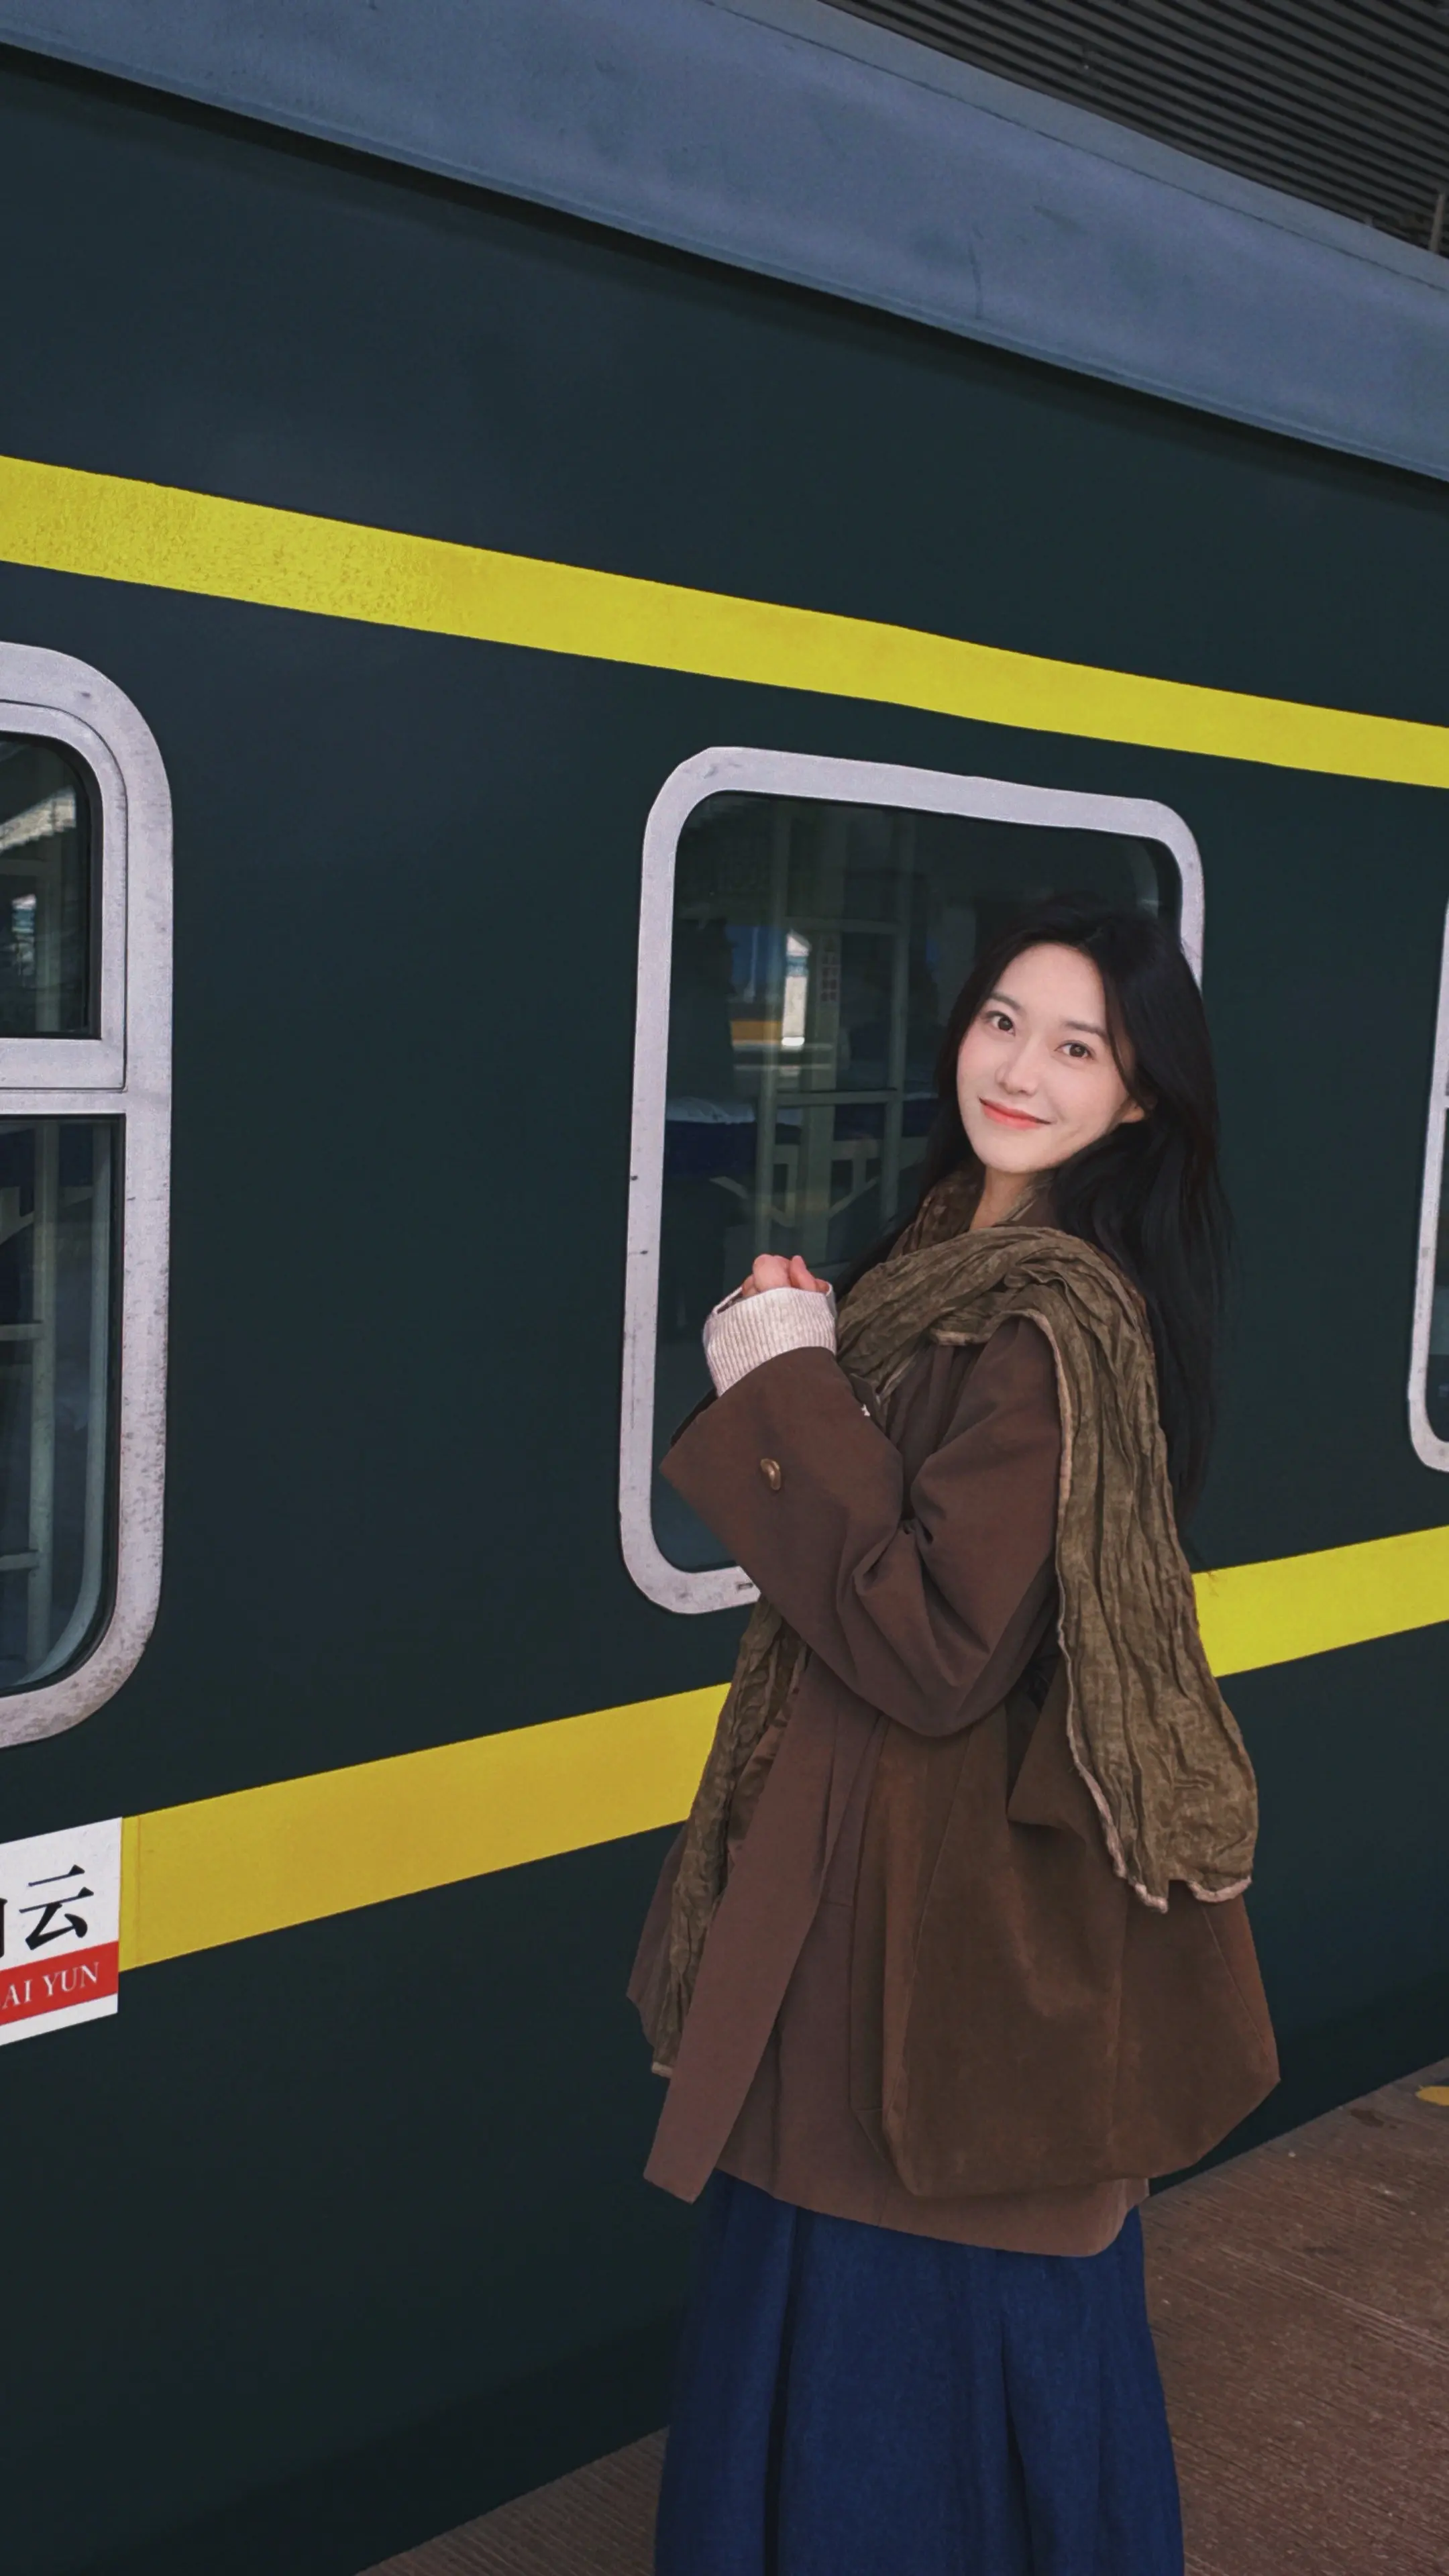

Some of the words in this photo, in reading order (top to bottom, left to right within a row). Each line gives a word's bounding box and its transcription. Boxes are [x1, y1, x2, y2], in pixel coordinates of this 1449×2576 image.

[0, 1864, 94, 1958] 云
[0, 1979, 32, 2010] AI
[42, 1962, 99, 1997] YUN
